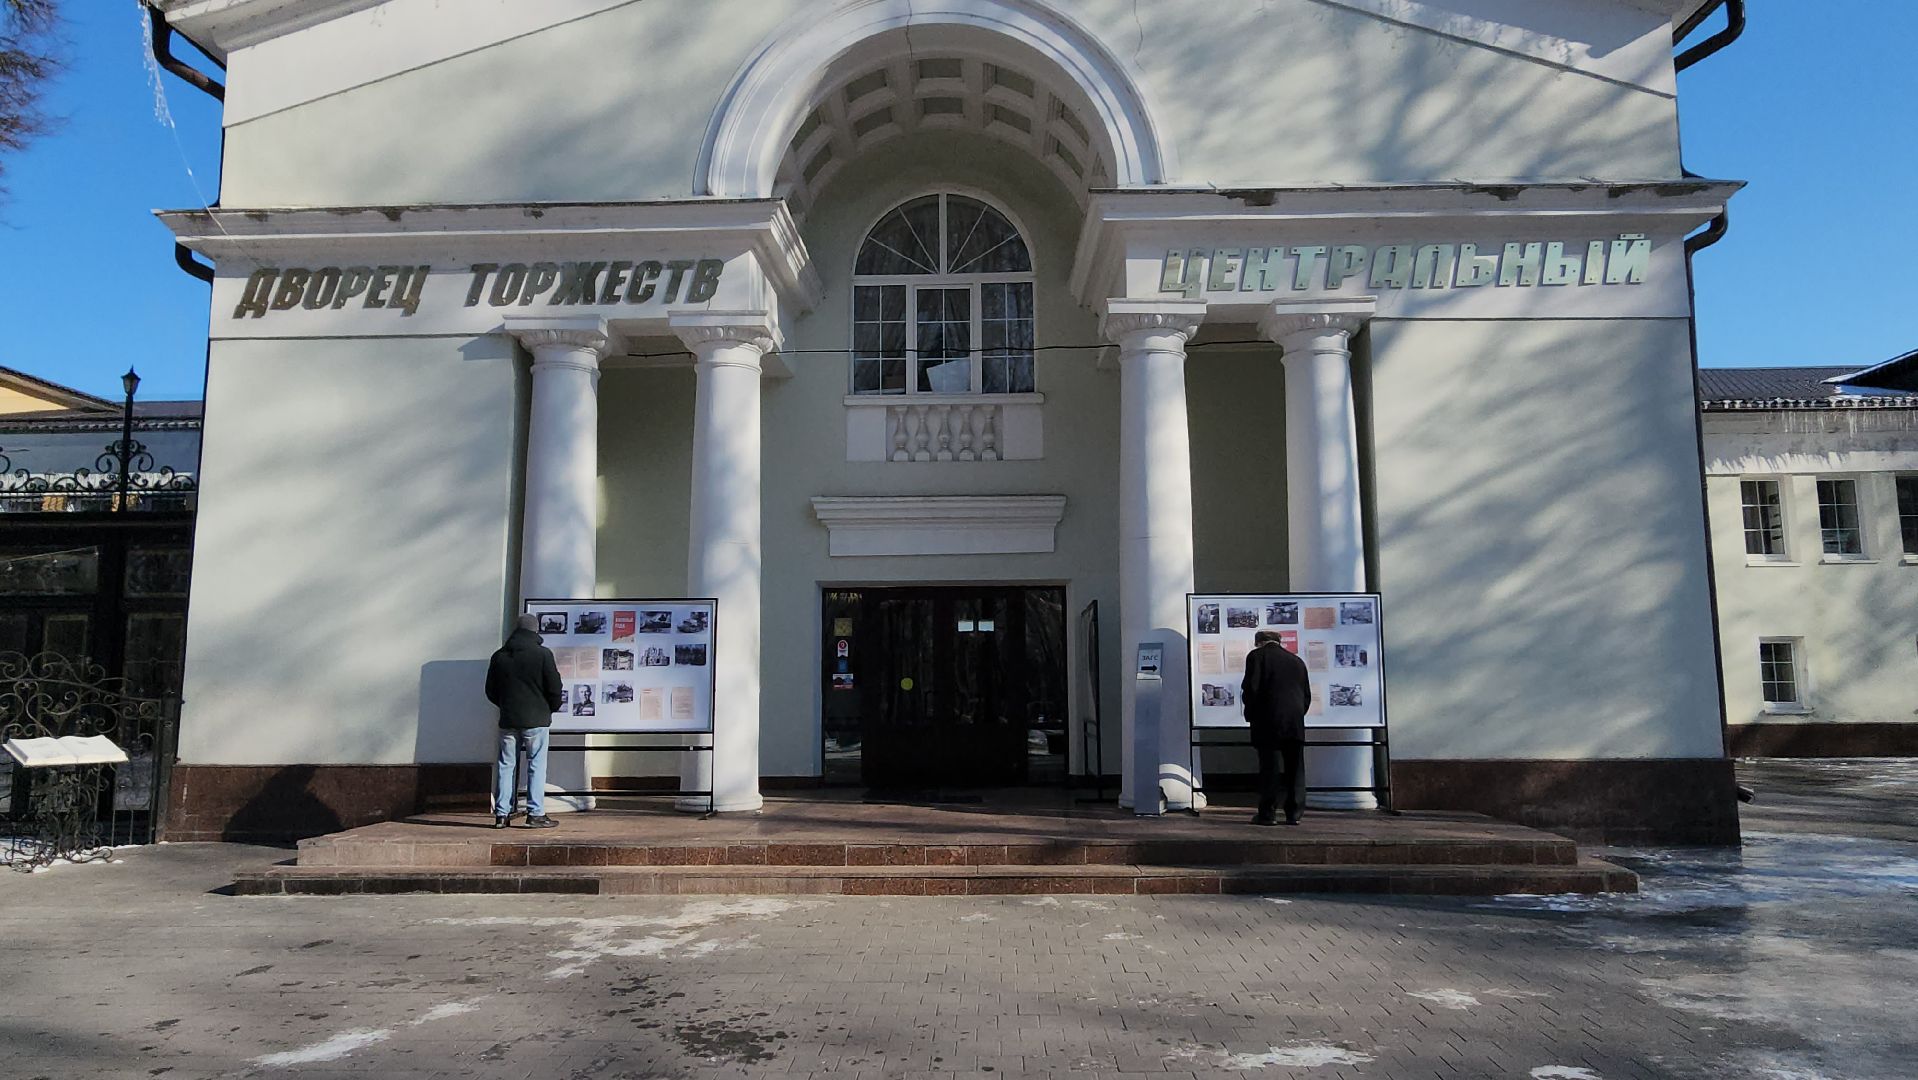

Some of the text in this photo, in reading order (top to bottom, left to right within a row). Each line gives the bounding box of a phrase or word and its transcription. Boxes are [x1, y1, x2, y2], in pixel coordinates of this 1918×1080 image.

[233, 259, 725, 318] ДВОРЕЦ ТОРЖЕСТВ
[1160, 233, 1652, 297] ЦЕНТРАЛЬНЫЙ
